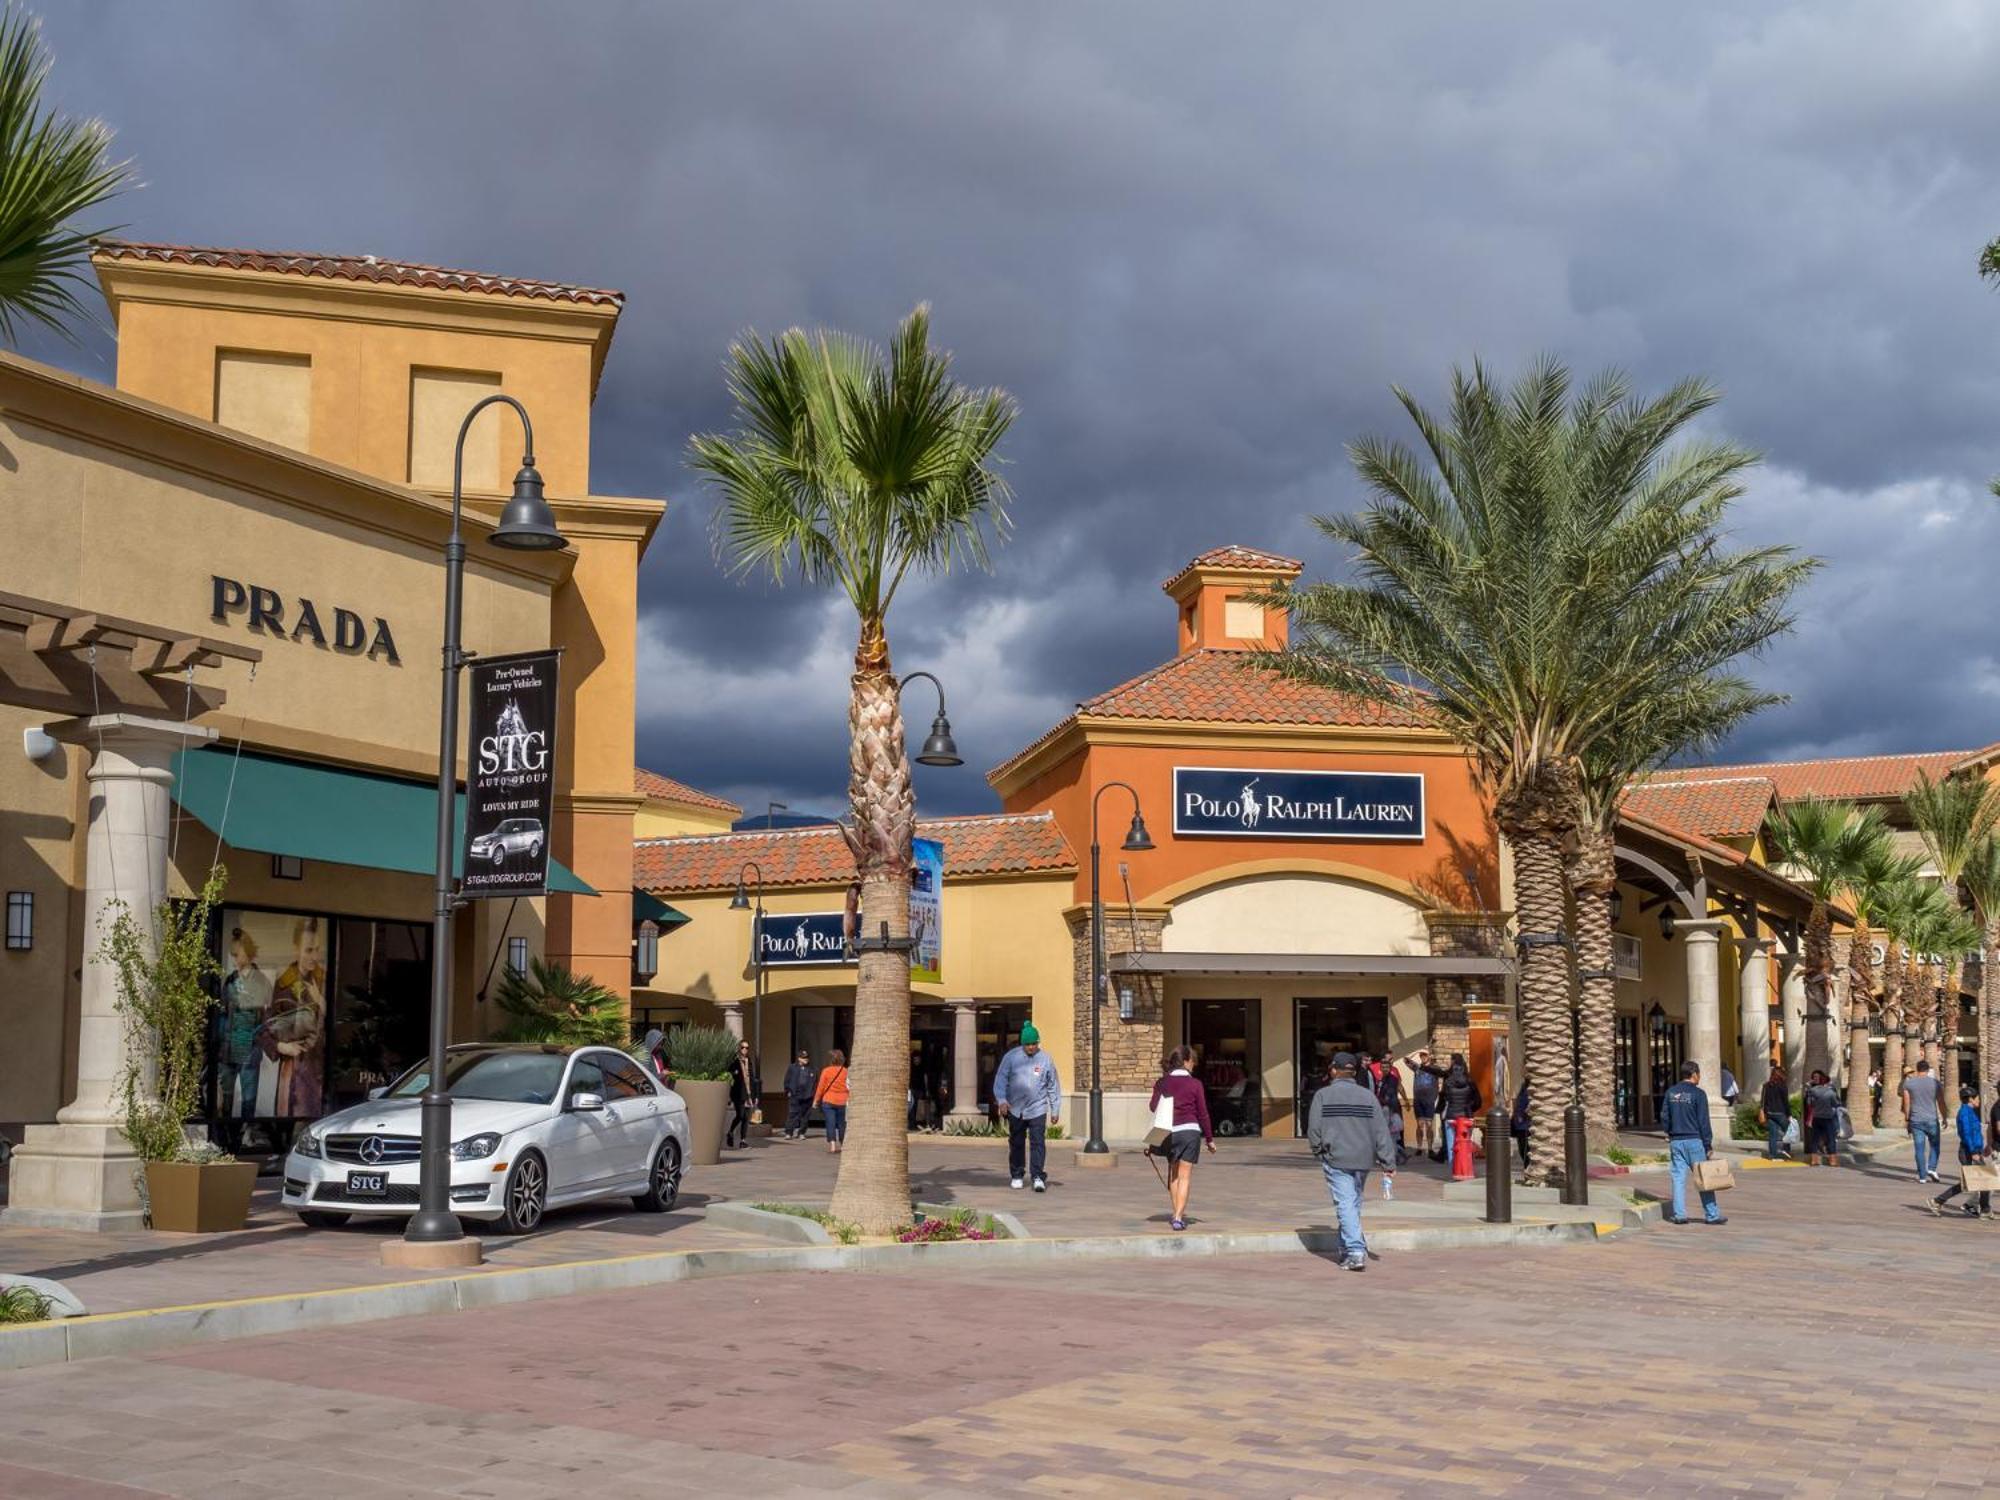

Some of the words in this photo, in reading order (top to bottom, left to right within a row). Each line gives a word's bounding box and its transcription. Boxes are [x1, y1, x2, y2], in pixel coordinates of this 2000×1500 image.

[210, 574, 402, 664] PRADA
[495, 665, 534, 680] Pre-Owned
[487, 682, 513, 693] Luxury
[513, 678, 543, 689] Vehicles
[478, 730, 549, 776] STG
[478, 777, 507, 788] AUTO
[511, 772, 549, 784] GROUP
[507, 800, 520, 811] MY
[520, 799, 540, 810] RIDE
[1184, 792, 1240, 817] POLO
[1266, 795, 1332, 820] RALPH
[1334, 796, 1414, 822] LAUREN
[466, 872, 543, 885] STGAUTOGROUP.COM
[760, 933, 796, 953] POLO
[812, 932, 848, 951] RALP
[351, 1175, 382, 1190] STG
